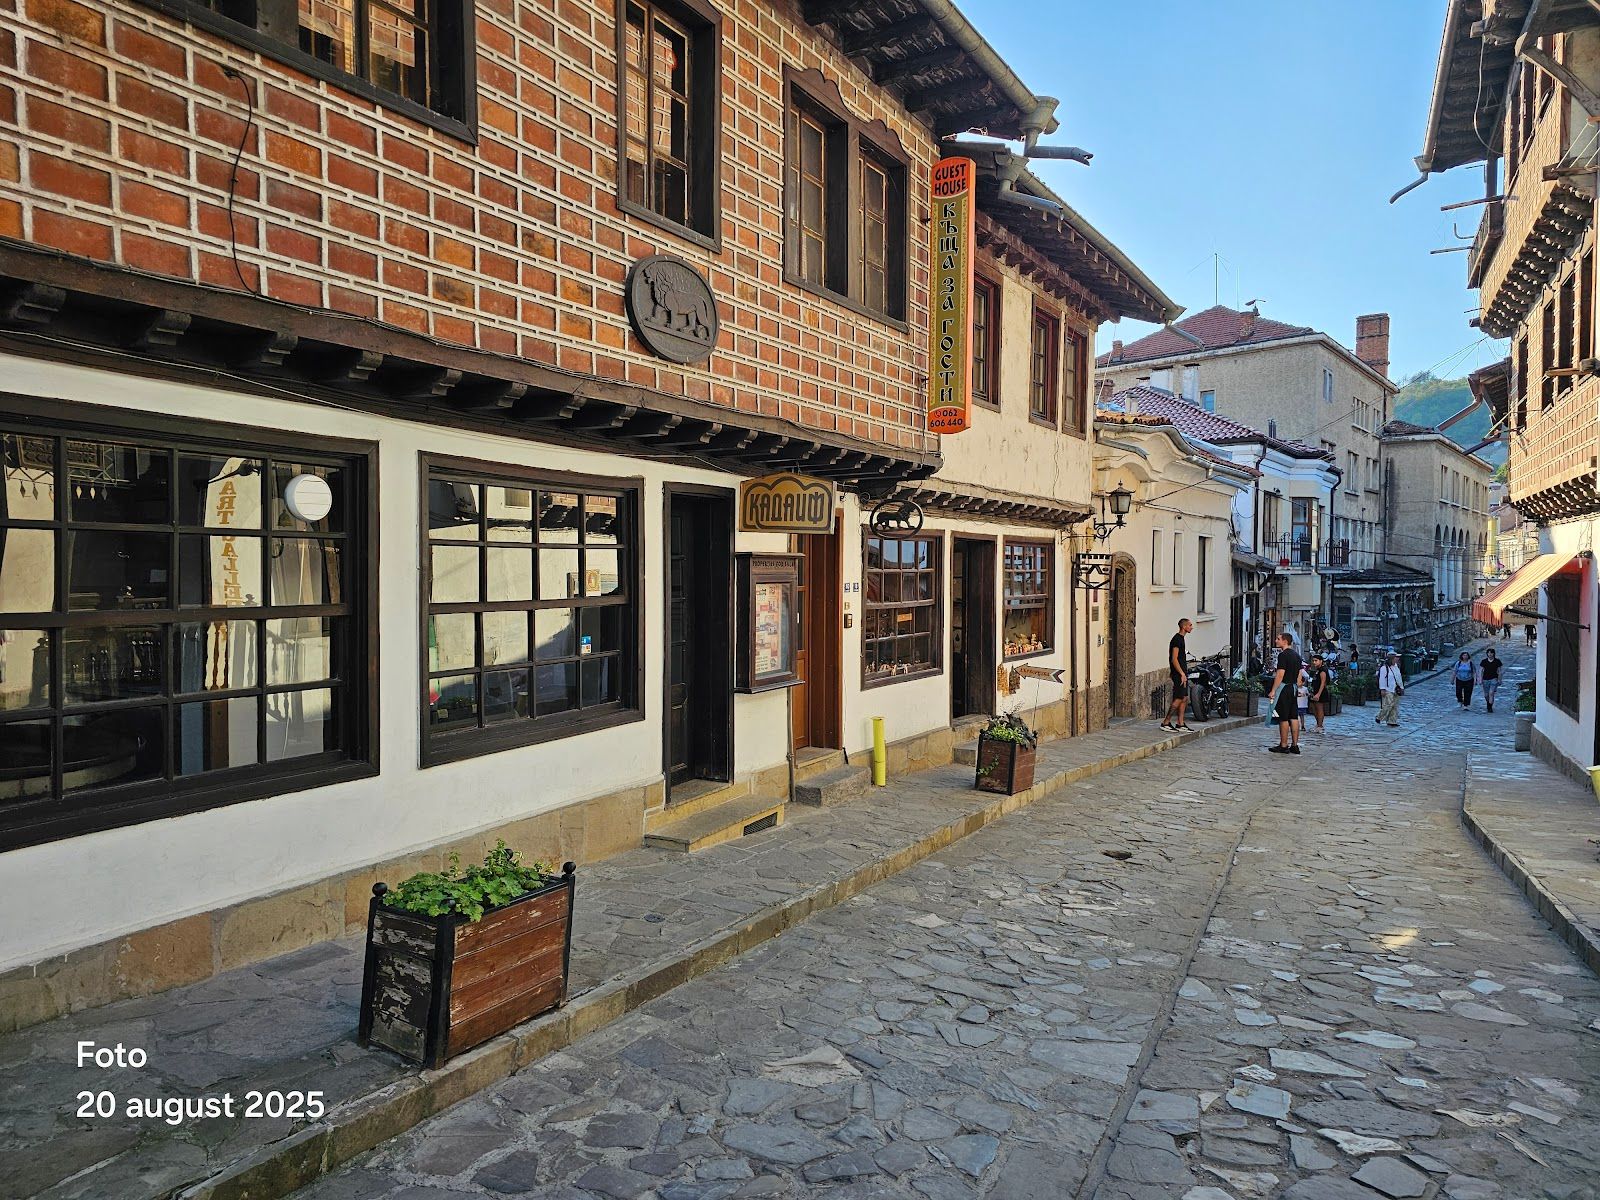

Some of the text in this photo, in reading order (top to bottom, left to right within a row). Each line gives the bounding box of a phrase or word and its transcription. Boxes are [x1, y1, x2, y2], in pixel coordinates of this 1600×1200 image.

[935, 164, 966, 180] GUEST
[934, 178, 966, 195] HOUSE
[939, 201, 959, 402] КЪЩА ЗА ГОСТИ
[930, 418, 963, 427] 606 440
[750, 492, 825, 524] КАДАИФ
